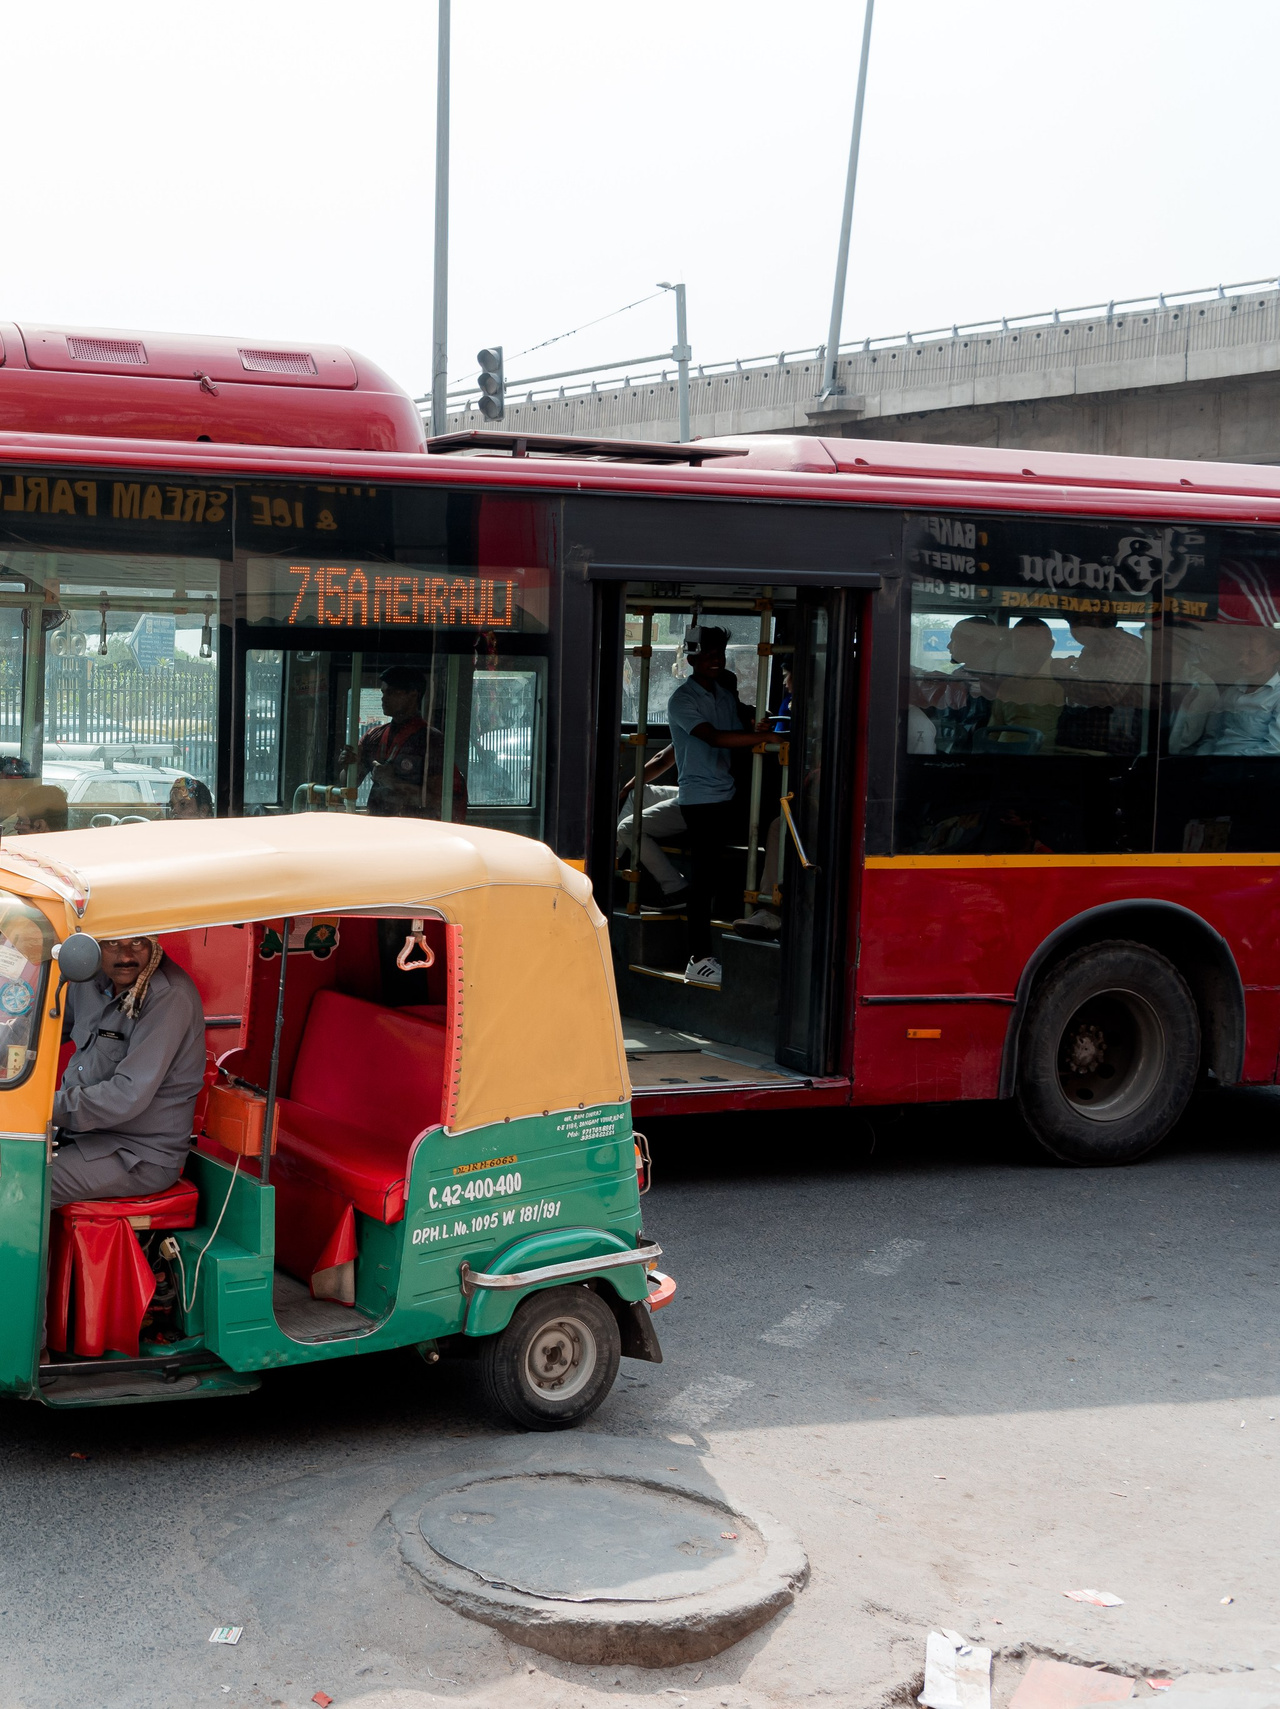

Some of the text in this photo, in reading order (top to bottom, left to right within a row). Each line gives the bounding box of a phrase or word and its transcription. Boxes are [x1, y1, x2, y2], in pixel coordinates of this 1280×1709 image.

[288, 566, 512, 626] 715A MEHRAULI
[471, 1212, 499, 1233] 1095
[519, 1199, 561, 1223] 181/191
